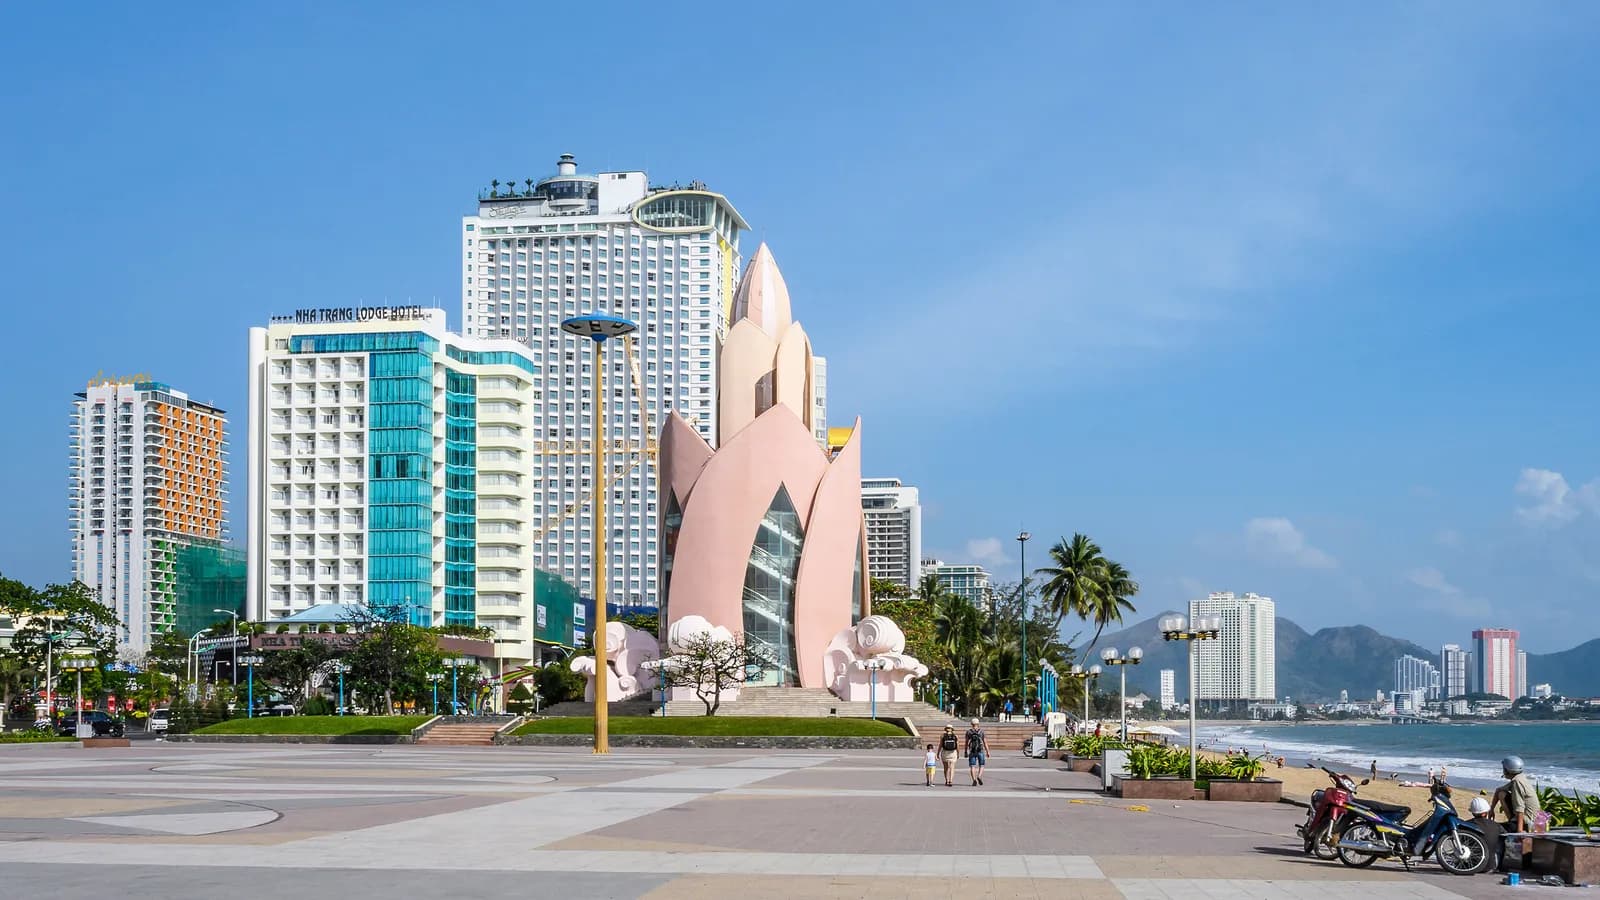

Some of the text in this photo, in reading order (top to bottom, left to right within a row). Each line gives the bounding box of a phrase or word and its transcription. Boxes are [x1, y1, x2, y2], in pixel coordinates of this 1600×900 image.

[295, 305, 424, 323] NHA TRANG LODGE HOTEL
